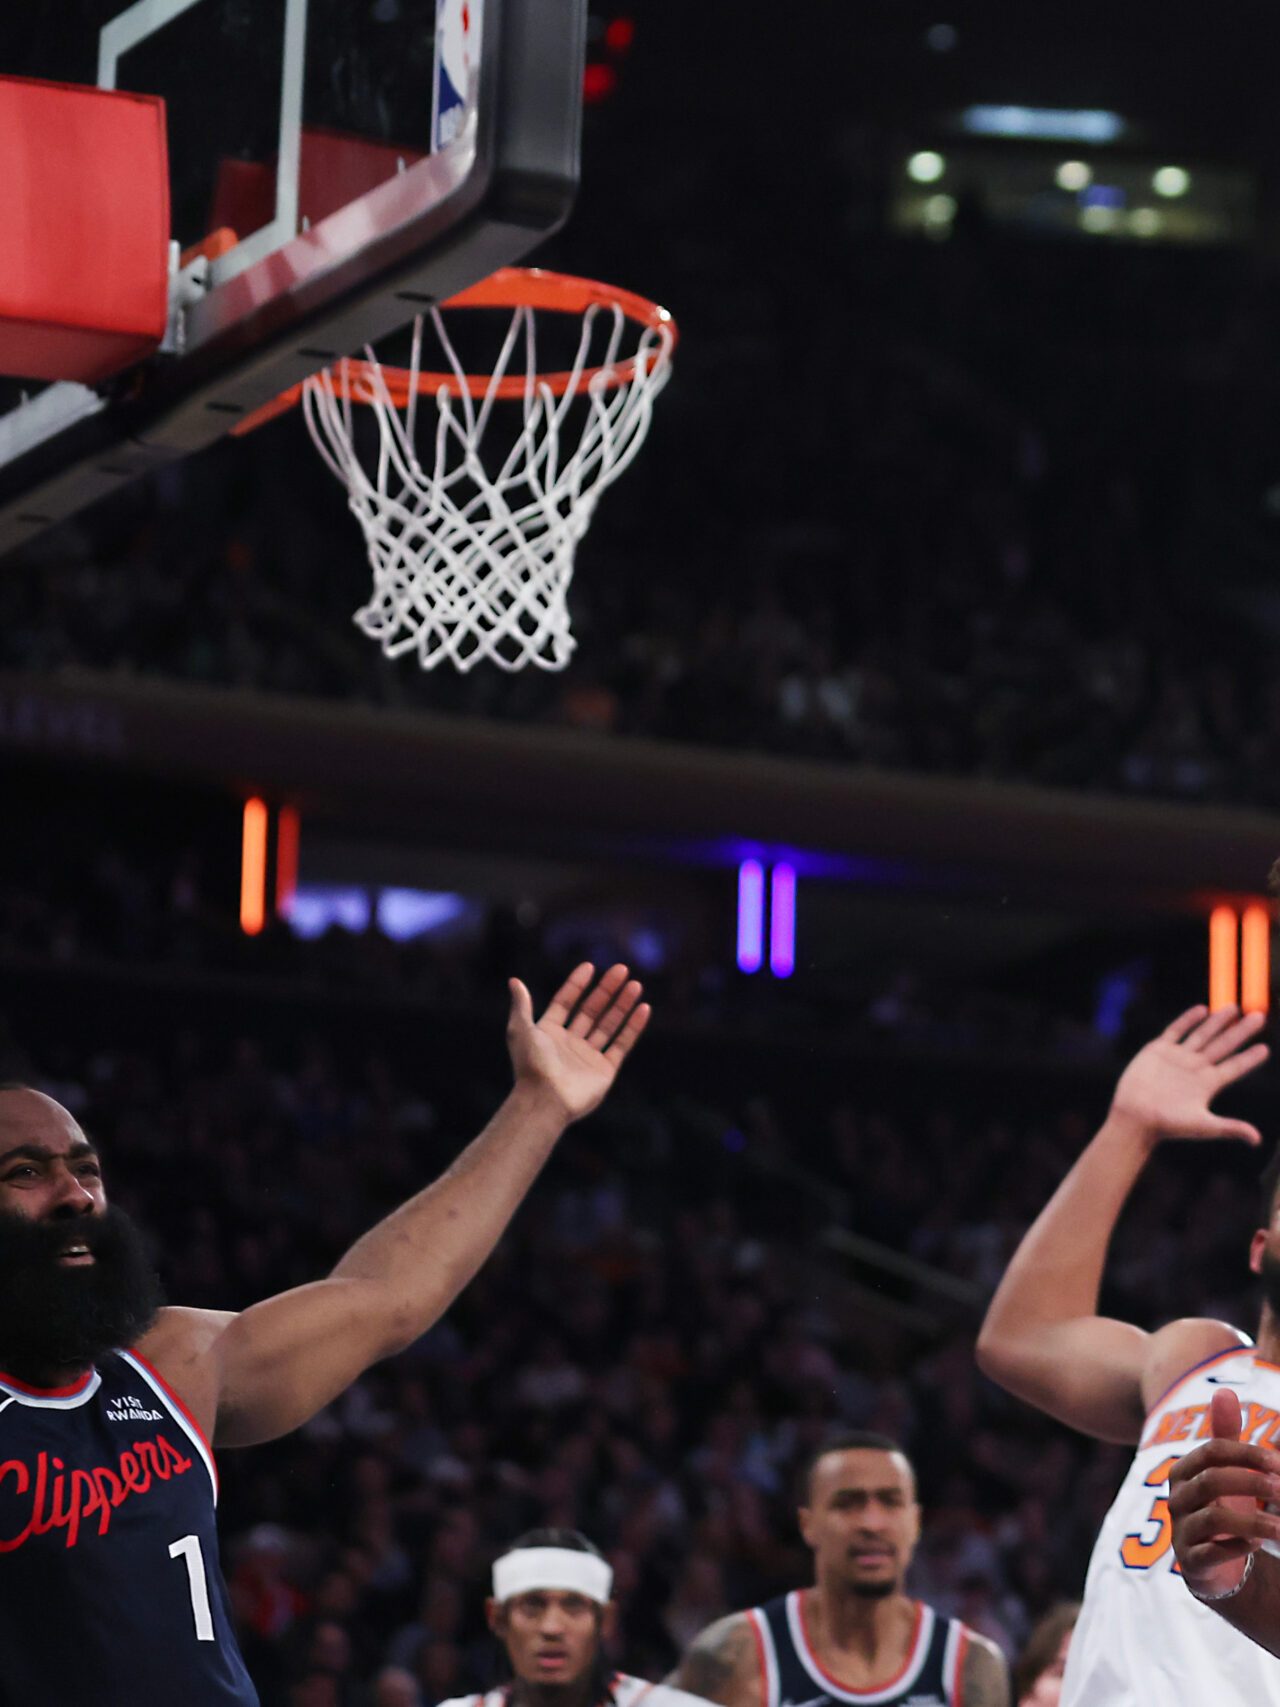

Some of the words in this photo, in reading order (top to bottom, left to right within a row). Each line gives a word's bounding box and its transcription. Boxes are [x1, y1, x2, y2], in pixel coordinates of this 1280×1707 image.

[106, 1408, 164, 1422] RWANDA
[0, 1434, 192, 1551] Clippers
[168, 1534, 215, 1641] 1
